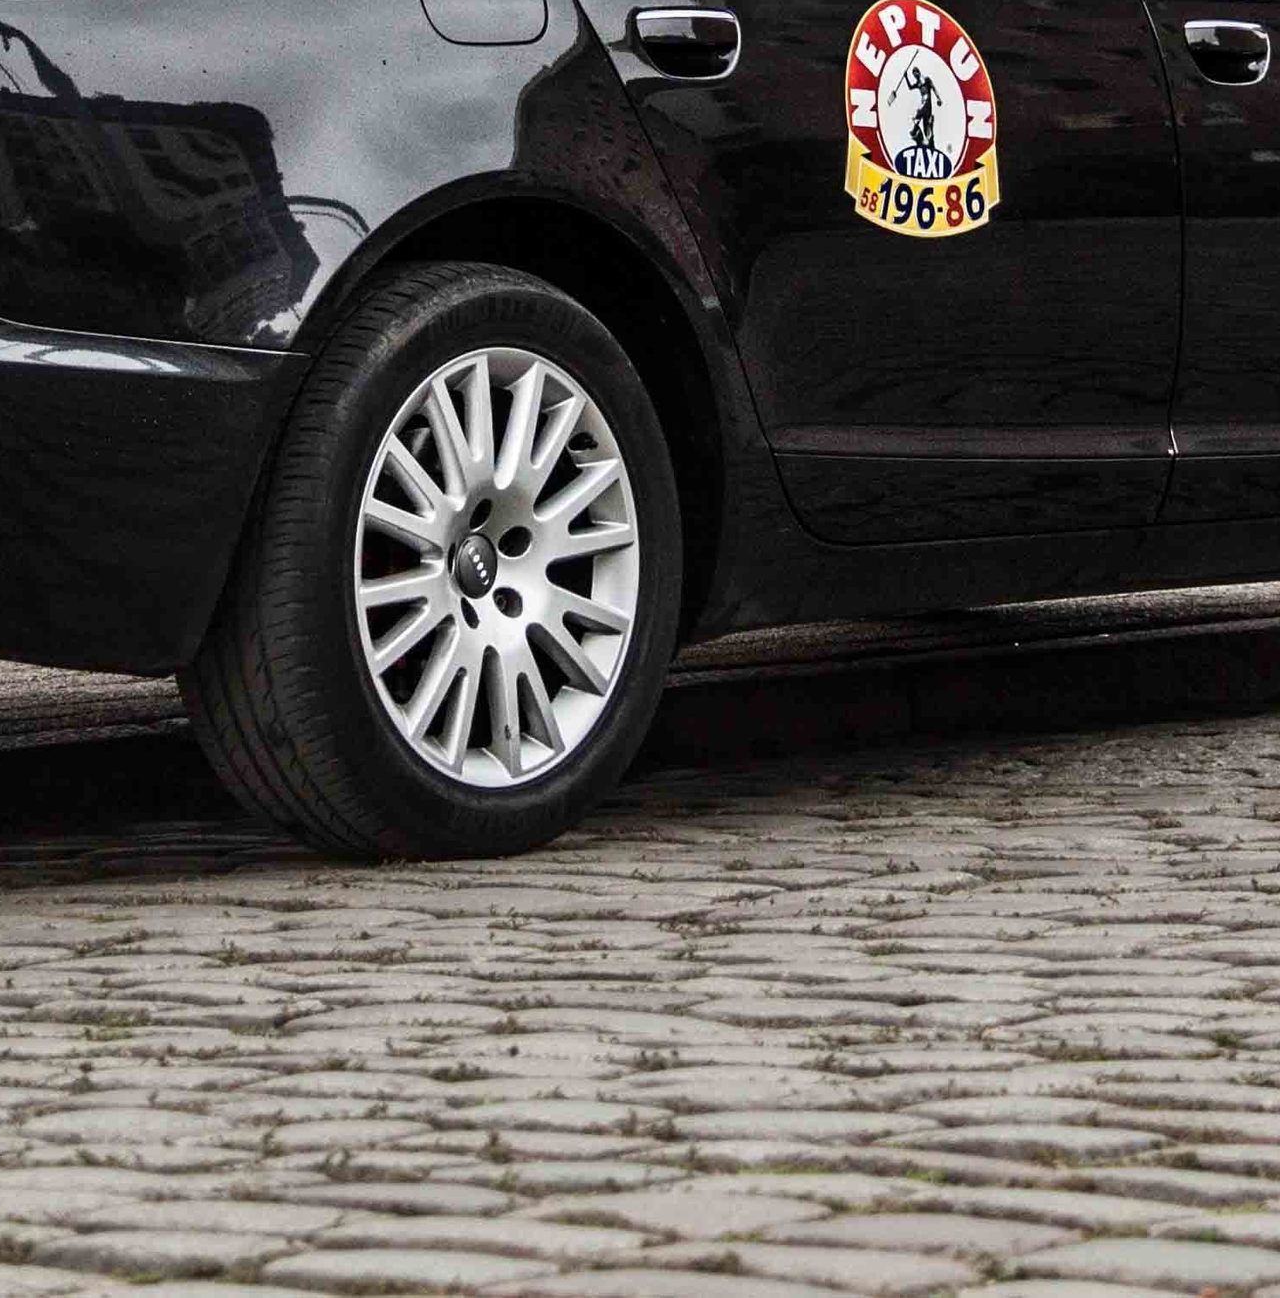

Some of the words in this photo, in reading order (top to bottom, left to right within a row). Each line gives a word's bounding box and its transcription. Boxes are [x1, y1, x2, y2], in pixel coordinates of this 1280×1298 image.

[850, 4, 993, 140] NEPTUN
[902, 148, 946, 179] TAXI
[860, 187, 879, 213] 58
[878, 176, 986, 230] 196-86
